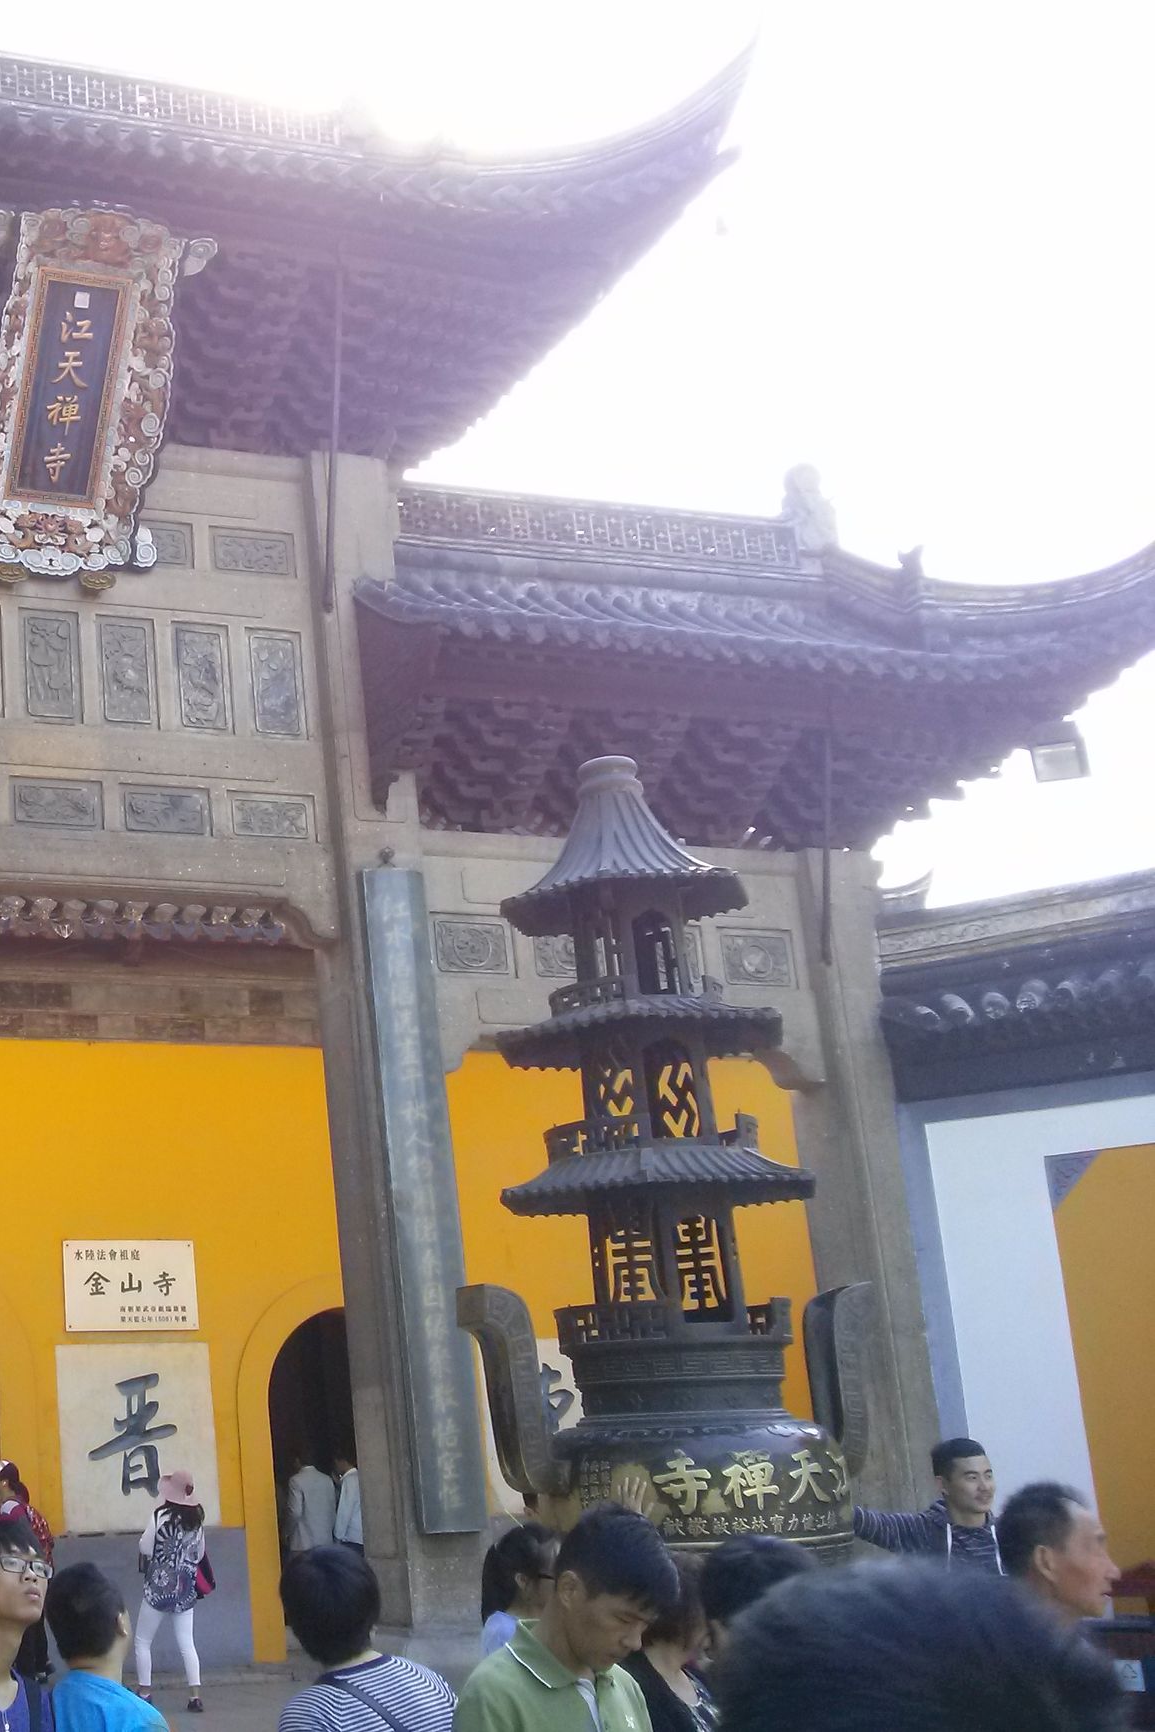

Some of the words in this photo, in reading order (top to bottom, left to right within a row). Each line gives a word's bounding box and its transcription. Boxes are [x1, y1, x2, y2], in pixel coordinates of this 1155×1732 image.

[83, 1271, 177, 1297] 金山寺
[88, 1372, 178, 1498] 晋
